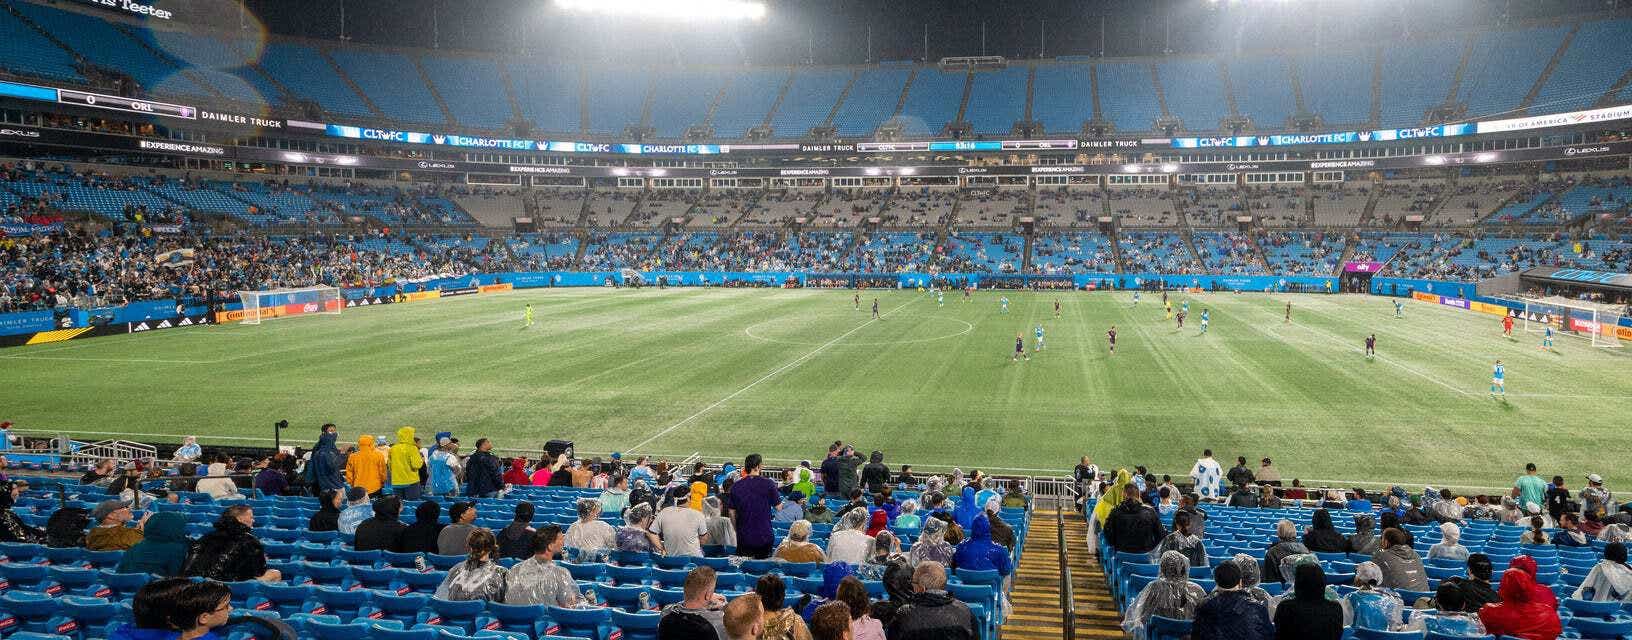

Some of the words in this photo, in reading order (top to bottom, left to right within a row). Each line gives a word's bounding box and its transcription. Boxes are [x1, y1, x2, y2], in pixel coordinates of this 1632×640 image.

[120, 0, 172, 19] Teeter
[87, 96, 95, 104] 0
[131, 101, 153, 111] ORL
[201, 111, 246, 123] DAIMLER
[250, 117, 281, 128] TRUCK
[1530, 118, 1568, 127] AMERICA
[1590, 110, 1630, 121] STADIUM
[460, 136, 512, 148] CHARLOTTE
[513, 140, 525, 149] FC
[1080, 140, 1112, 148] DAIMLER
[1282, 134, 1332, 145] CHARLOTTE
[1332, 133, 1346, 143] FC
[643, 144, 686, 153] CHARLOTTE
[687, 144, 698, 153] FC
[1356, 263, 1370, 271] ally
